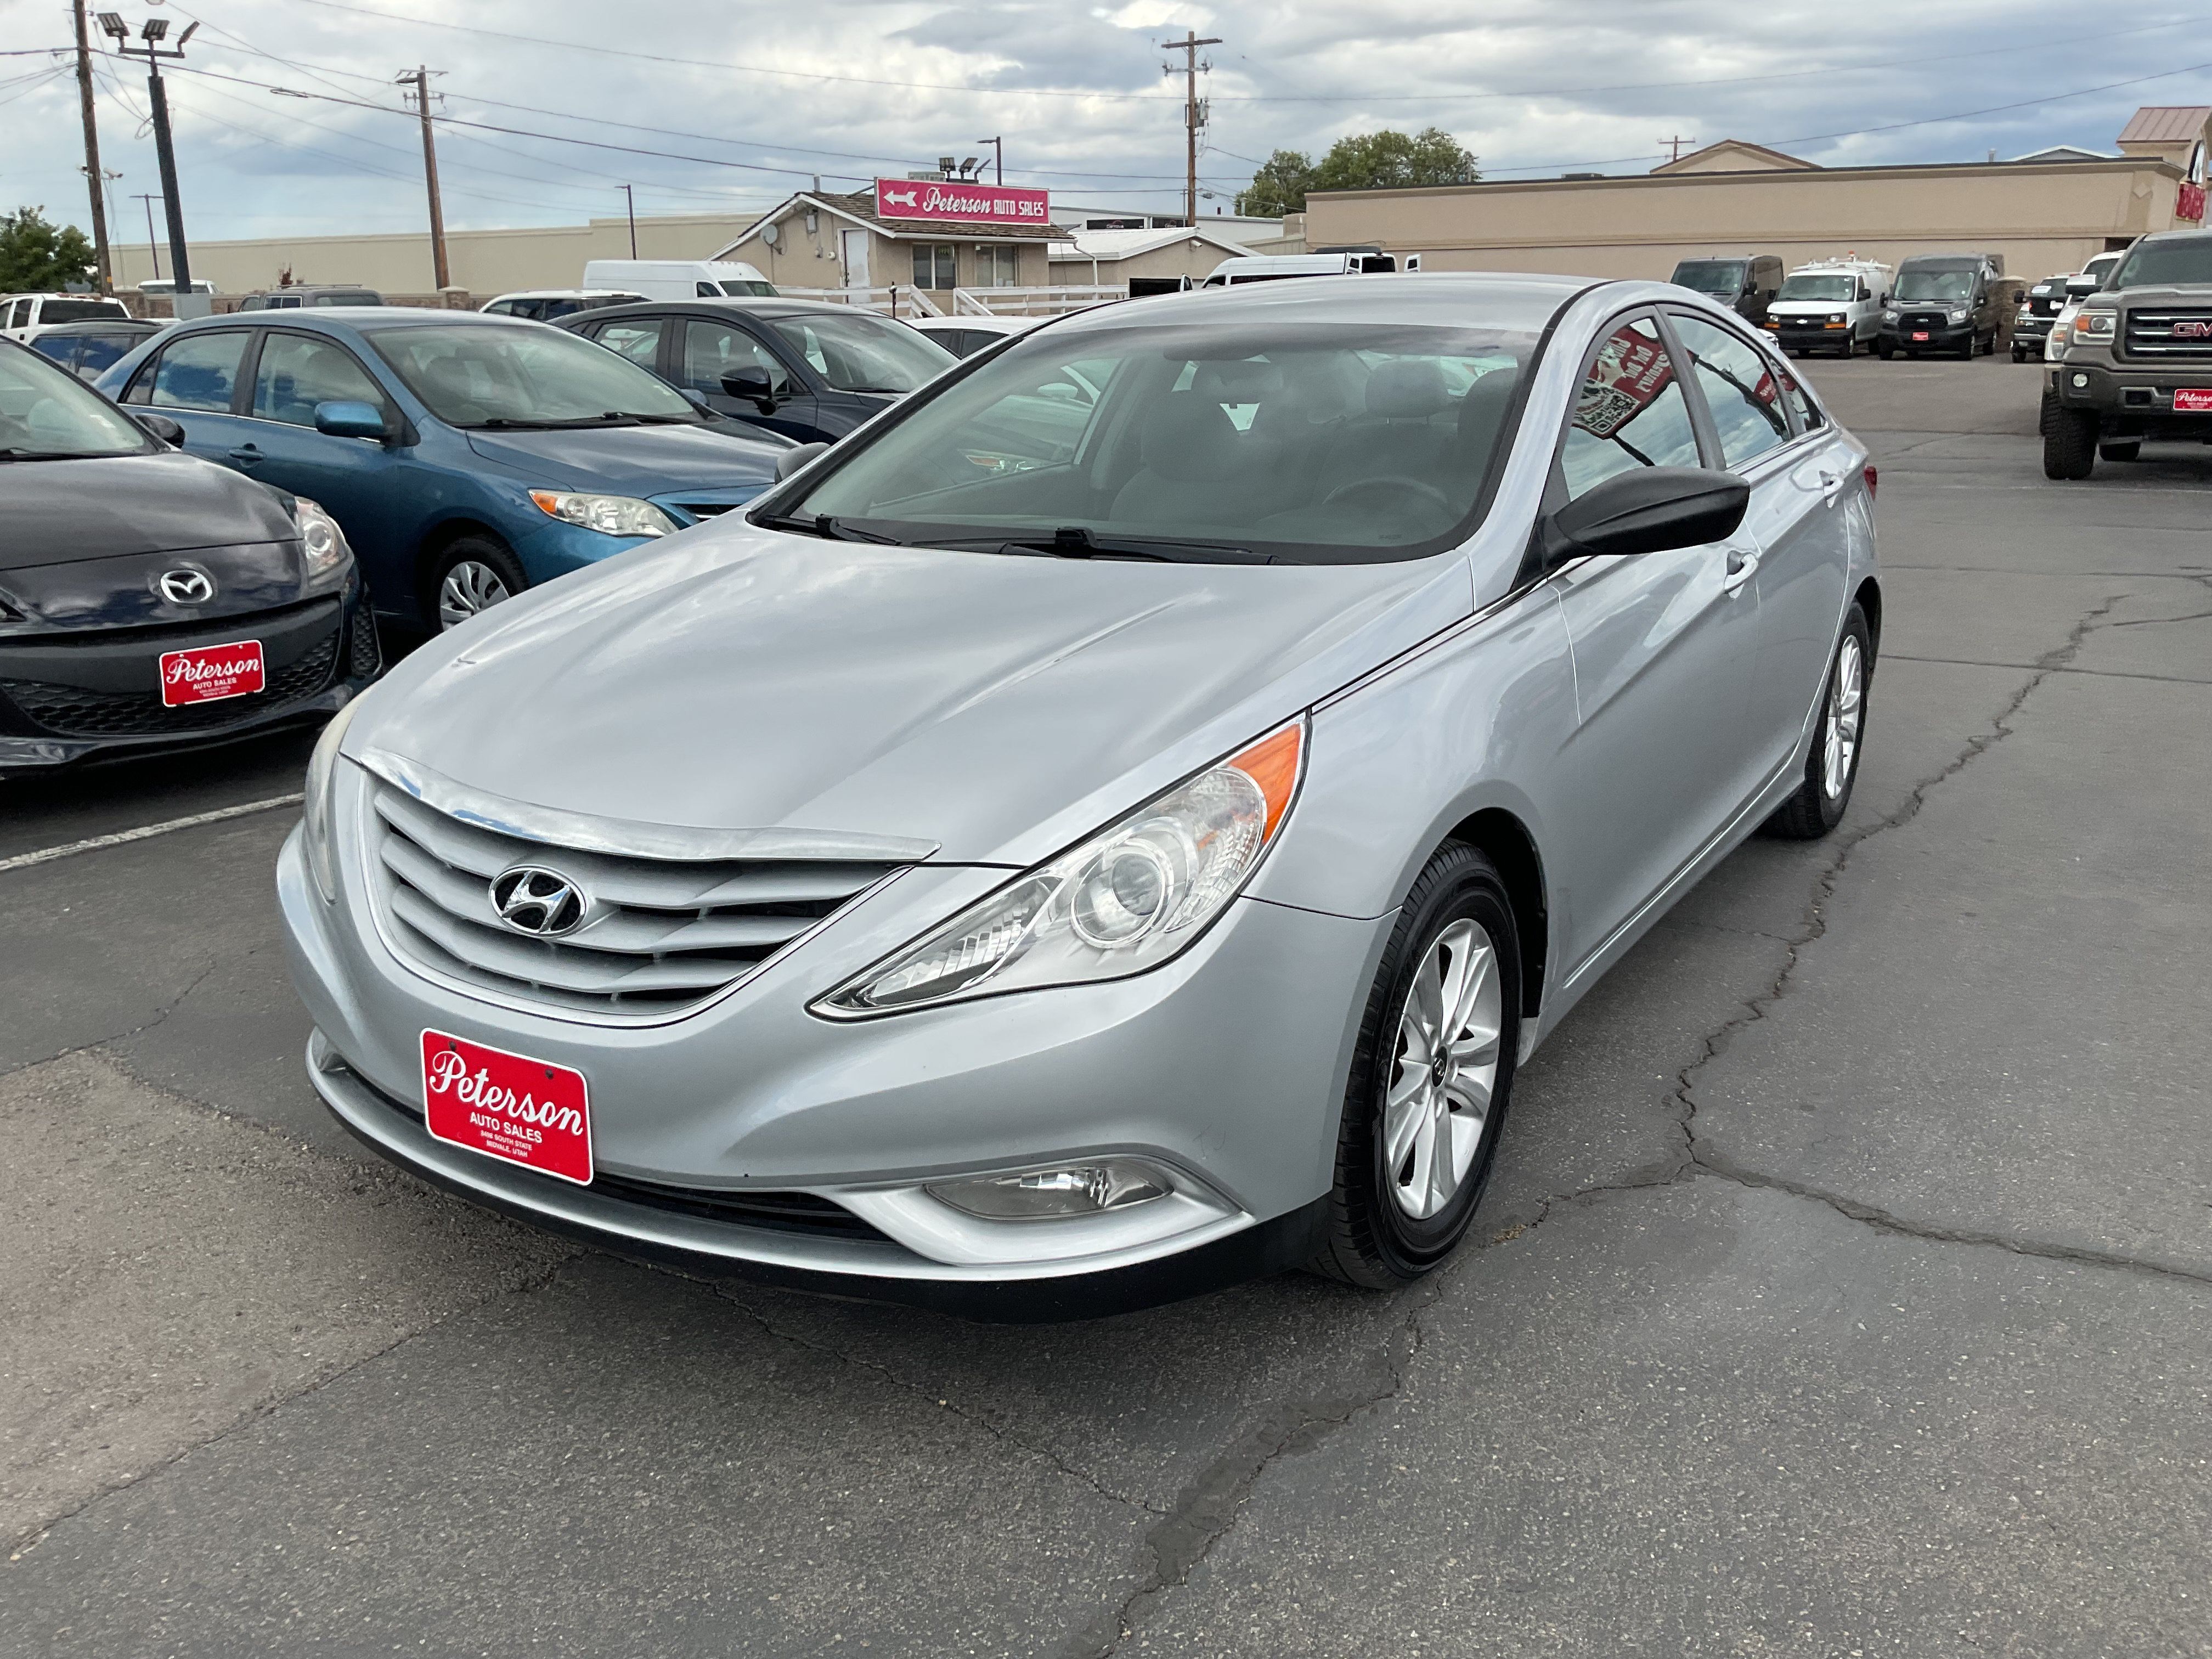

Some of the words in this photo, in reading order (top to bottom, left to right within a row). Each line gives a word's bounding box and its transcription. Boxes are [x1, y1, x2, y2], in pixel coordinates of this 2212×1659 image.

[923, 187, 991, 213] Peterson
[994, 199, 1015, 215] AUTO
[1019, 200, 1044, 216] SALES
[166, 658, 259, 684] Peterson
[193, 681, 212, 690] AUTO
[214, 677, 237, 686] SALES
[429, 1051, 583, 1136] Peterson
[470, 1111, 500, 1131] AUTO
[504, 1122, 543, 1143] SALES
